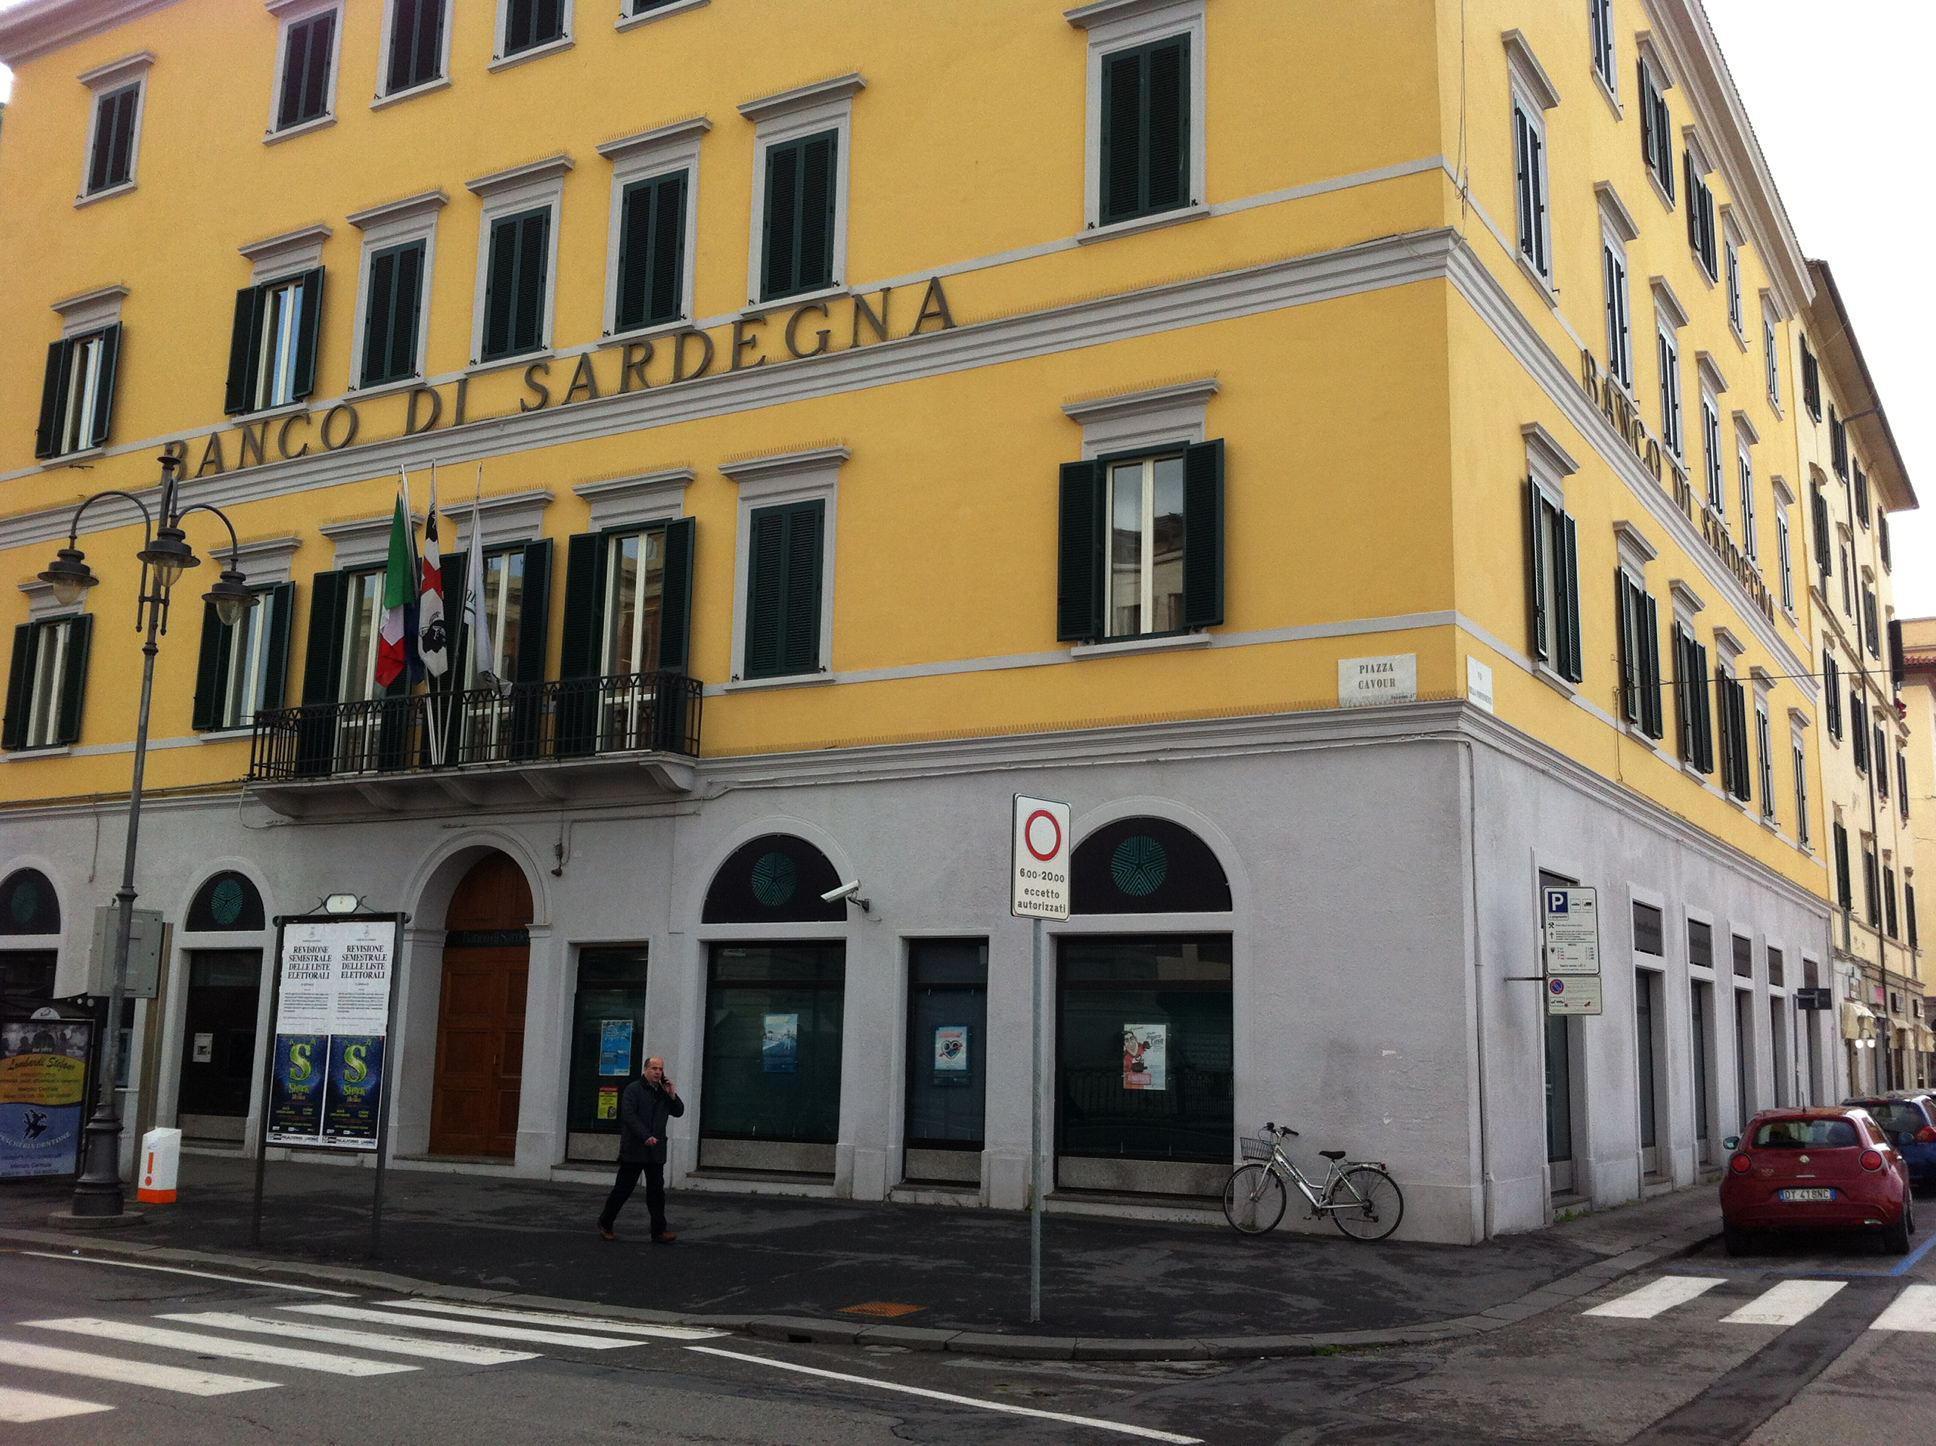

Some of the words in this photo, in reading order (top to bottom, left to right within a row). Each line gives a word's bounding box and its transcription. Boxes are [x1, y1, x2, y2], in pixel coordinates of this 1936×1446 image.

[160, 403, 360, 488] BANCO
[404, 376, 470, 436] DI
[519, 276, 957, 412] SARDEGNA
[1581, 349, 1661, 483] BANCO
[1671, 467, 1691, 524] DI
[1359, 662, 1394, 674] PIAZZA
[1358, 677, 1396, 690] CAVOUR
[1024, 888, 1060, 899] eccetto
[1017, 900, 1066, 913] autorizzati
[1551, 893, 1564, 911] P
[293, 946, 330, 954] REVISIONE
[346, 945, 384, 953] REVISIONE
[341, 954, 387, 962] SEMESTRALE
[288, 963, 310, 971] DELLE
[311, 963, 331, 971] LISTE
[341, 962, 364, 970] DELLE
[365, 962, 385, 970] LISTE
[287, 972, 330, 980] ELETTORALI
[340, 971, 385, 979] ELETTORALI
